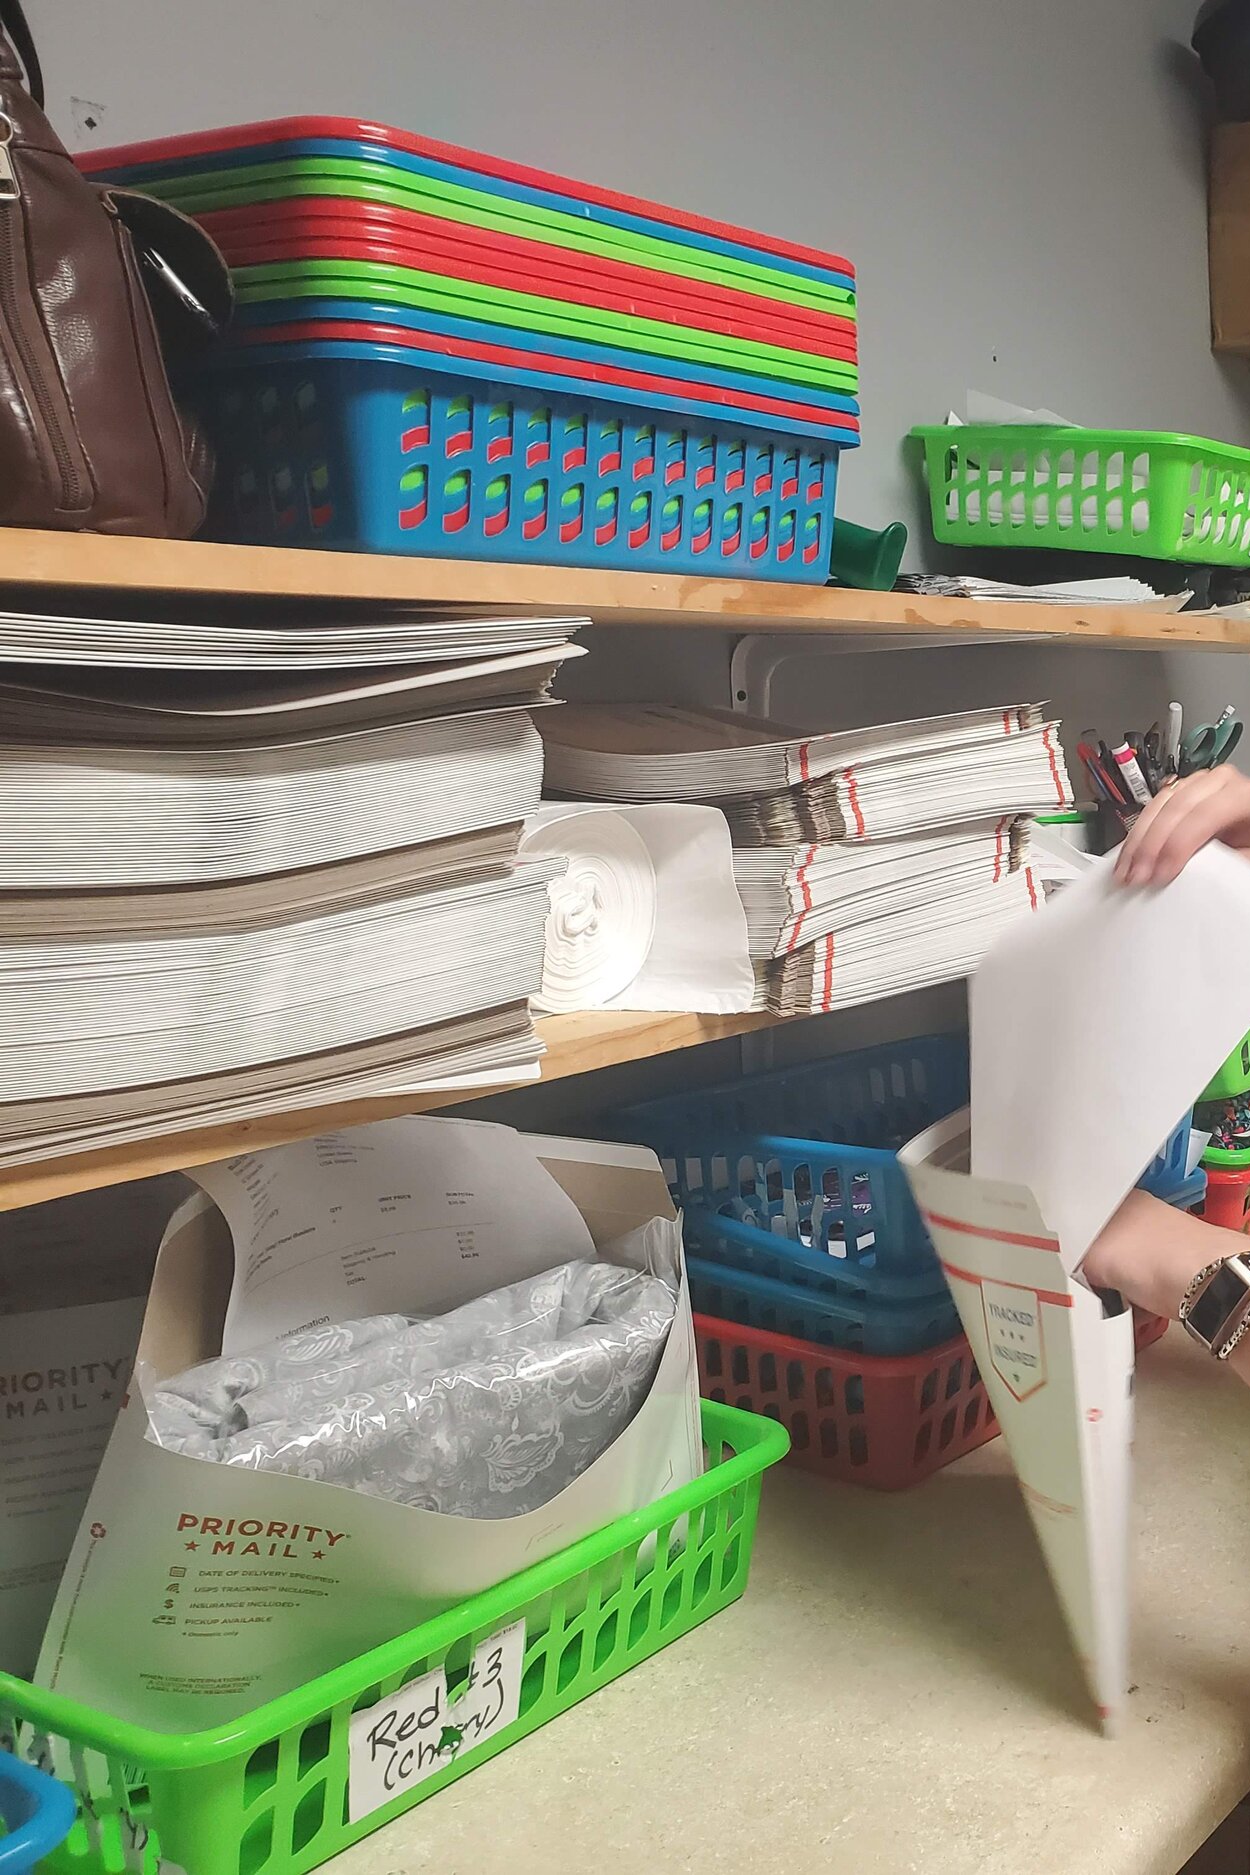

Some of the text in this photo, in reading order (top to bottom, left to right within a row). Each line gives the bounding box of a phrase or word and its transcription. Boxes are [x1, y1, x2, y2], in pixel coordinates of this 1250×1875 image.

[989, 1303, 1035, 1327] TRACKED
[6, 1393, 88, 1419] MAIL
[211, 1540, 298, 1558] MAIL
[241, 1570, 287, 1578] DELIVERY
[189, 1601, 245, 1609] INSURANCE
[185, 1616, 273, 1625] PICKUP AVAILABLE
[367, 1686, 440, 1762] Red
